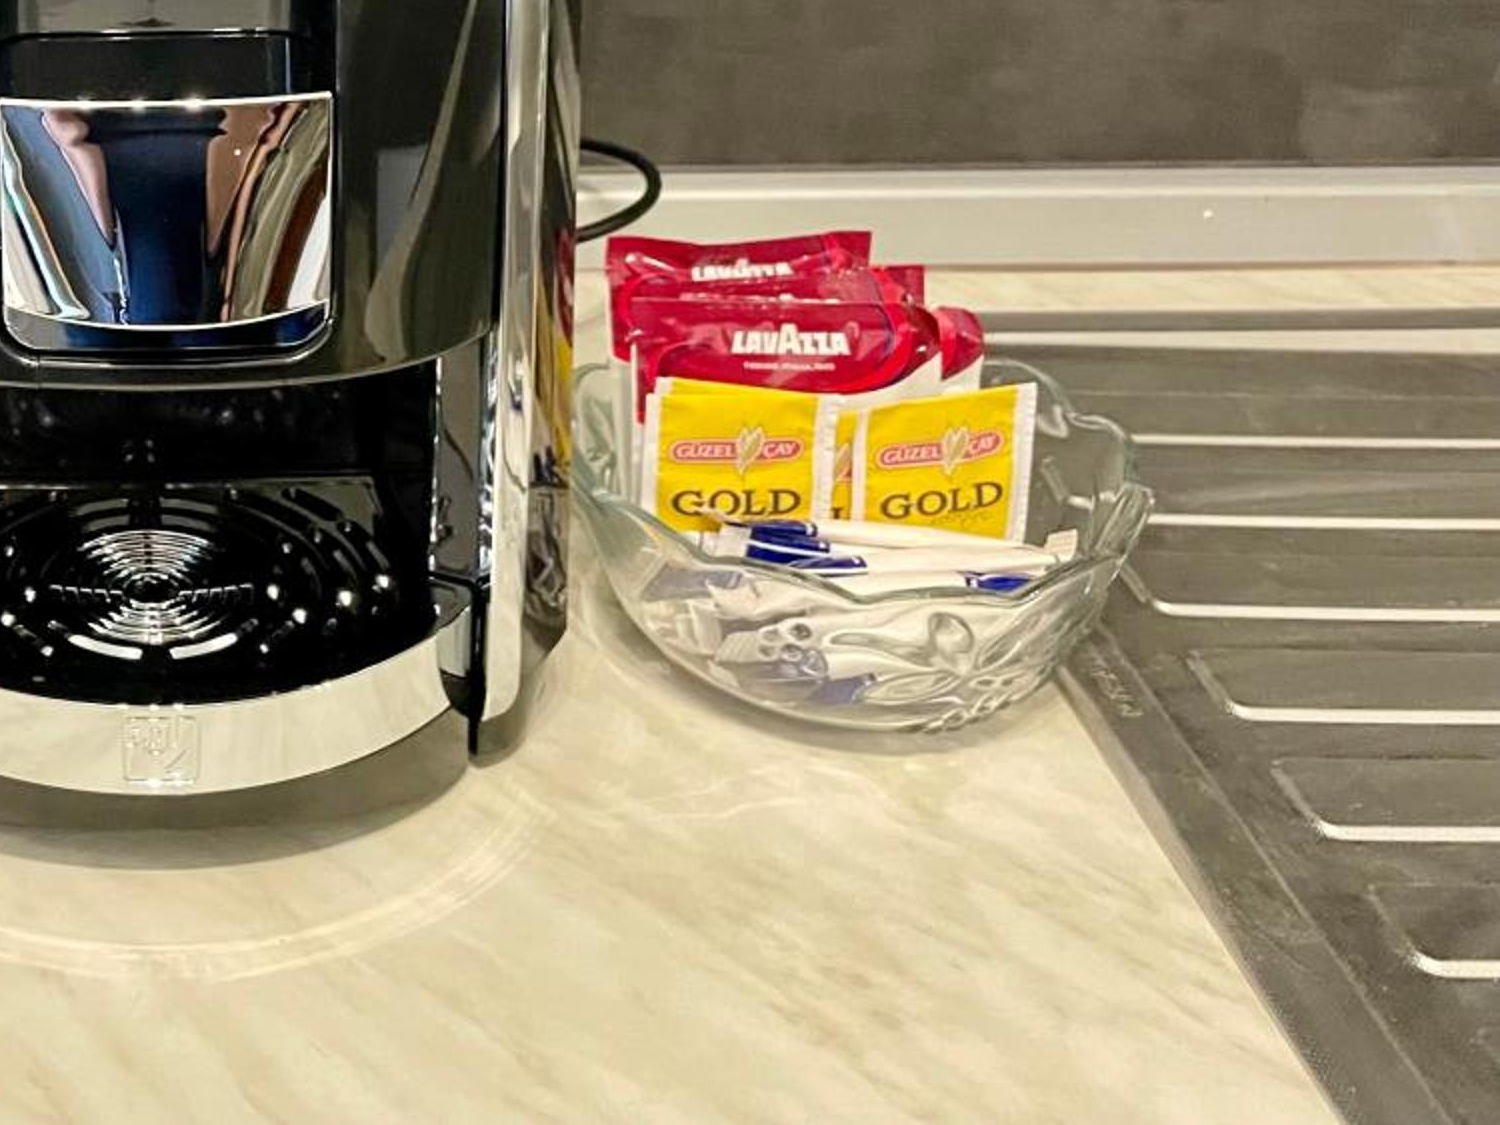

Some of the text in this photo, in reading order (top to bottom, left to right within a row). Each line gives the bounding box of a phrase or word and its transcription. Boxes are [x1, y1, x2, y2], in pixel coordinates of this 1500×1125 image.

[731, 322, 850, 355] LAVAZZA
[672, 489, 802, 516] GOLD
[881, 482, 1003, 519] GOLD
